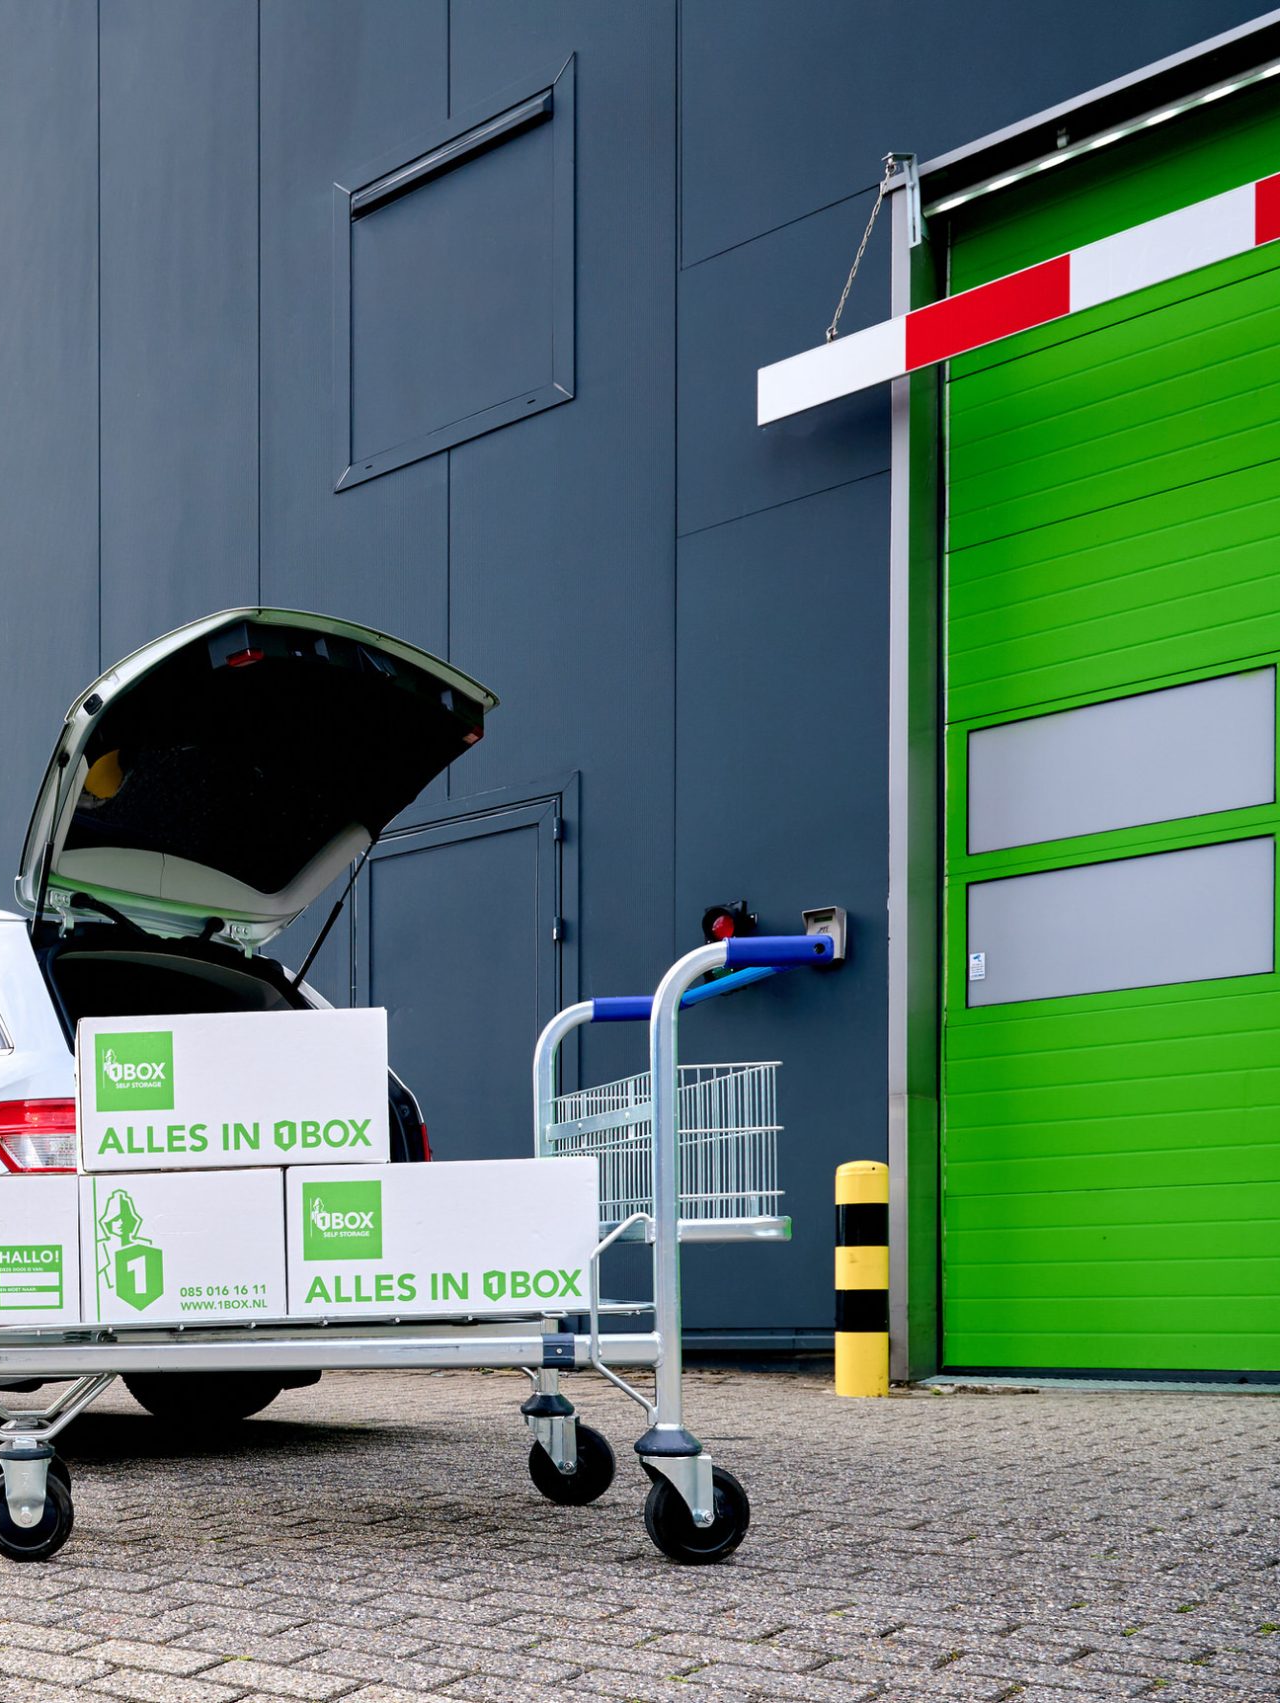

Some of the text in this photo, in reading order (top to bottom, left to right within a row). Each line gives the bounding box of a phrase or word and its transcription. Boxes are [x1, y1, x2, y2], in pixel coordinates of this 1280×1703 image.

[97, 1123, 208, 1155] ALLES
[222, 1122, 260, 1151] IN
[0, 1250, 60, 1264] HALLO!
[180, 1283, 266, 1297] 085 016 16 11
[305, 1272, 417, 1303] ALLES
[431, 1272, 469, 1301] IN
[180, 1299, 268, 1310] WWW.1BOX.NL
